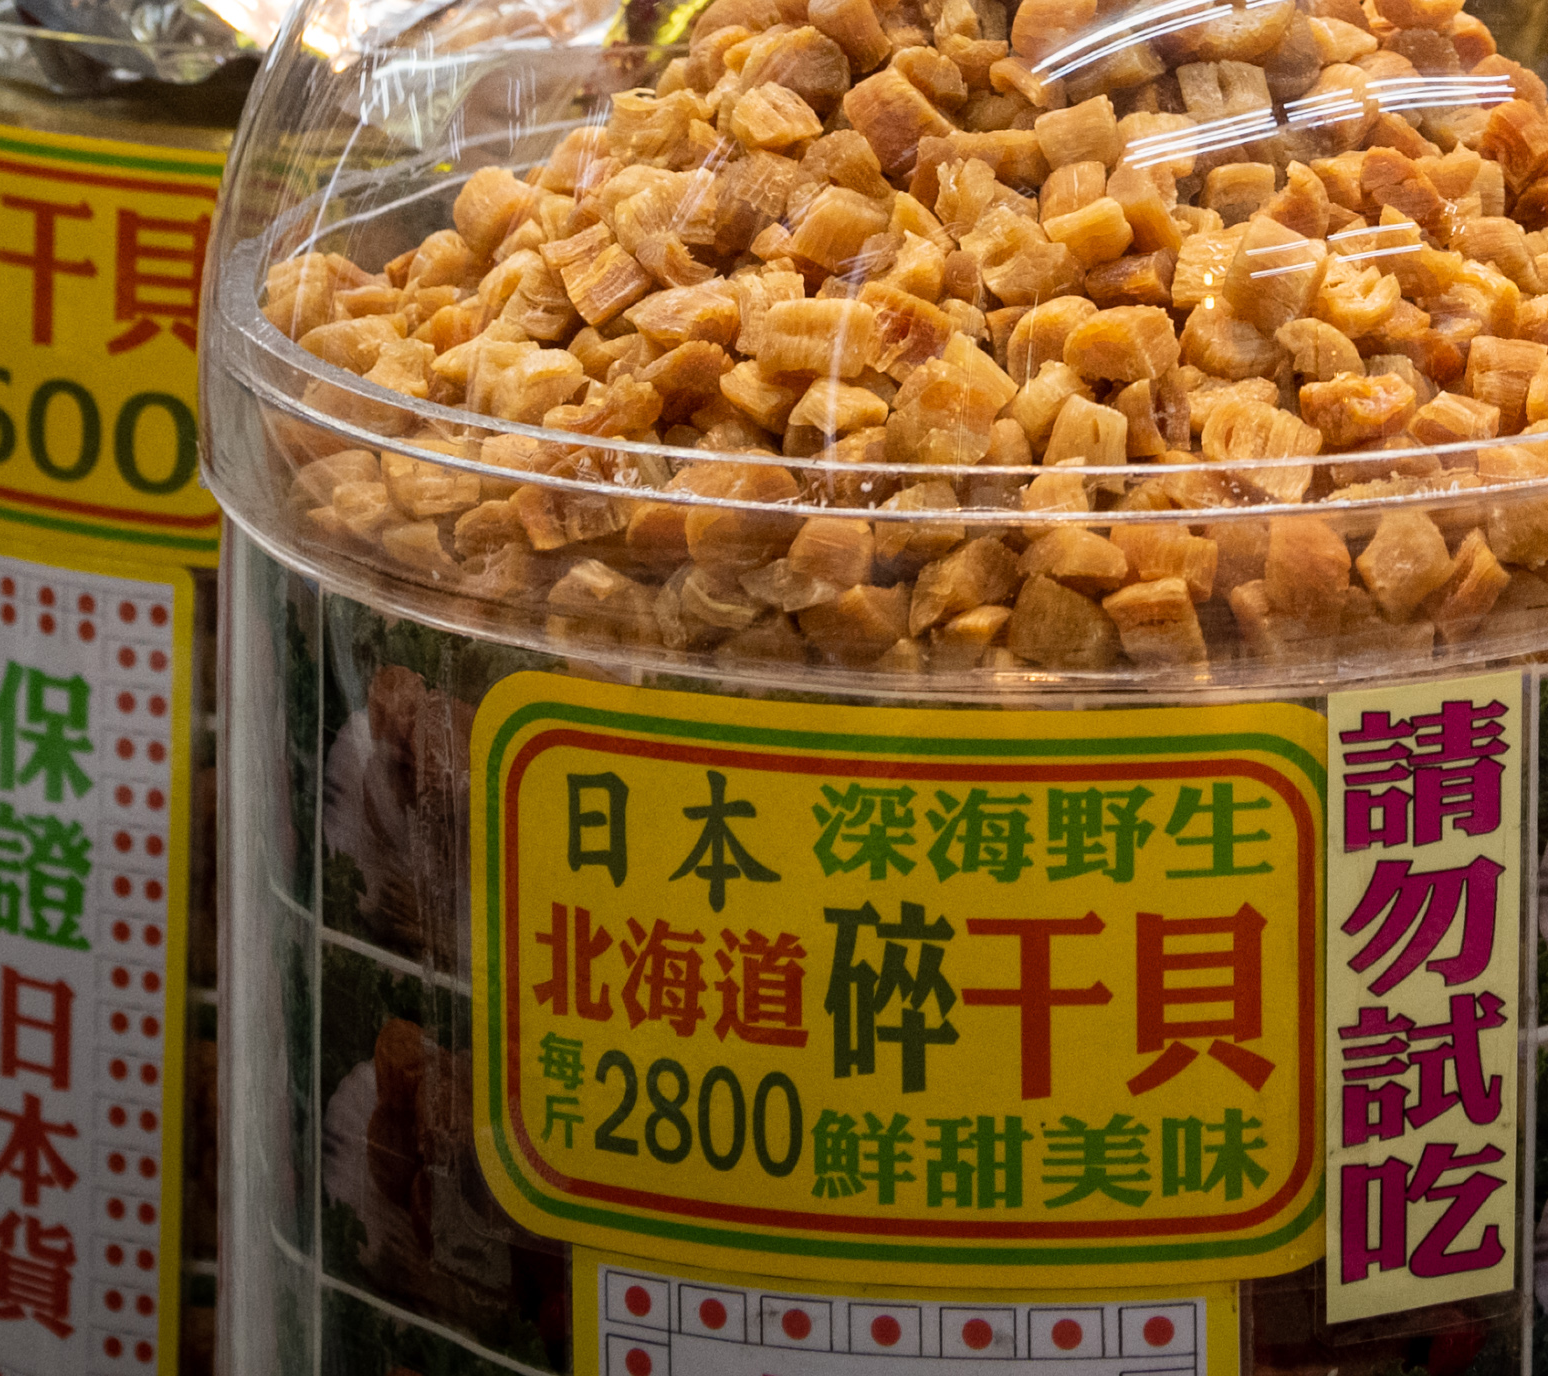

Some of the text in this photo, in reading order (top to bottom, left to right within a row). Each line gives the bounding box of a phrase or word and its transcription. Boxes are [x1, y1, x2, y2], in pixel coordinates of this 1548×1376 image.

[567, 770, 1277, 914] 日本 深海野生
[534, 900, 1277, 1101] 北海道 碎干貝
[1338, 698, 1511, 1288] 請勿試吃
[537, 1032, 1270, 1210] 每斤 2800 鮮甜美味
